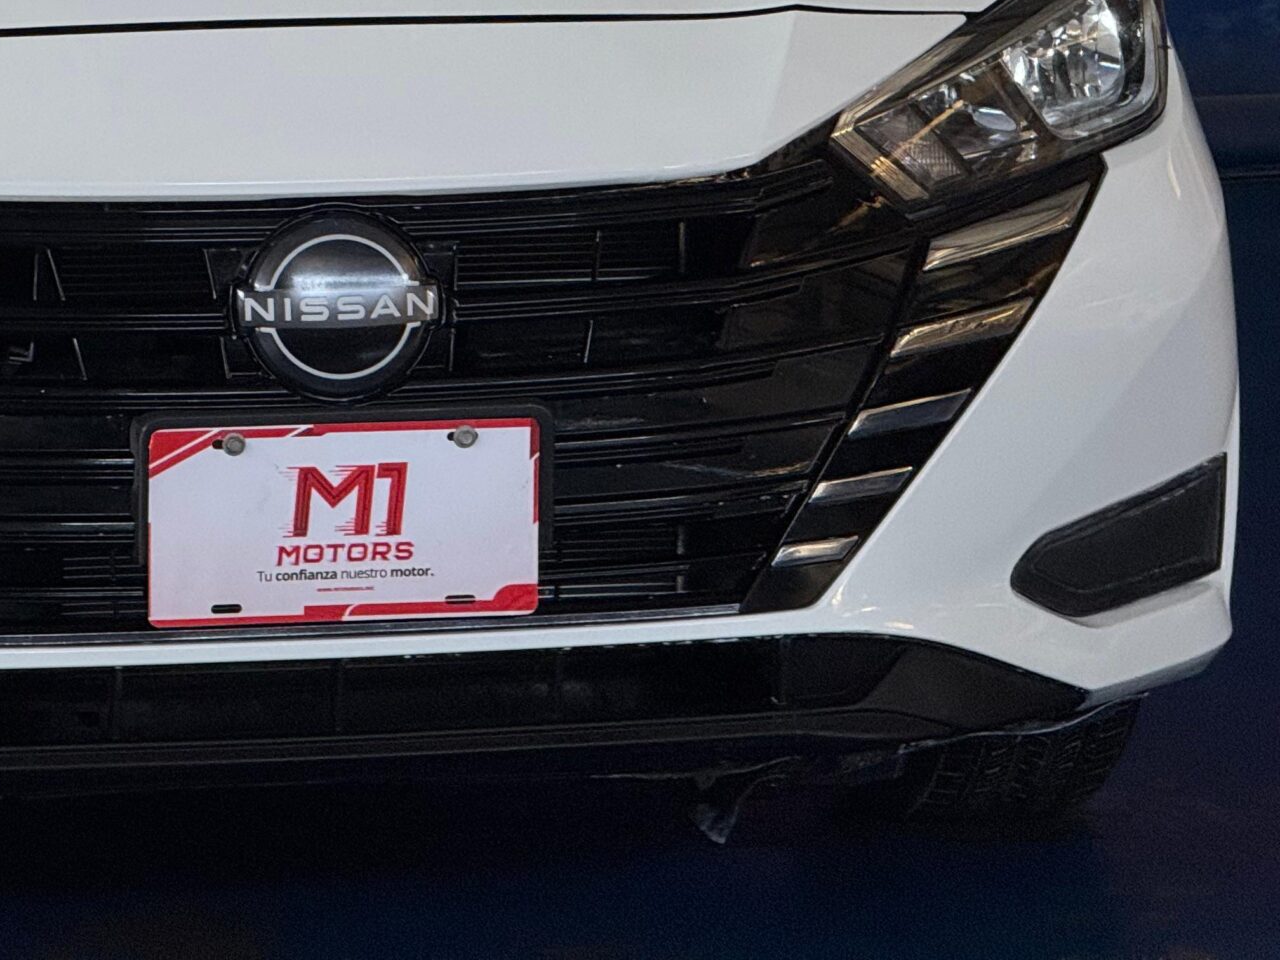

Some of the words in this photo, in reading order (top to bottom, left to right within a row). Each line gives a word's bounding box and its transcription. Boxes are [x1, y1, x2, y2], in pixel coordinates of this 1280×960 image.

[244, 292, 434, 322] NISSAN
[278, 461, 408, 539] M1
[276, 542, 415, 567] MOTORS
[257, 570, 273, 582] Tu
[275, 568, 338, 582] confianza
[340, 568, 388, 580] nuestro
[390, 566, 435, 578] motor.
